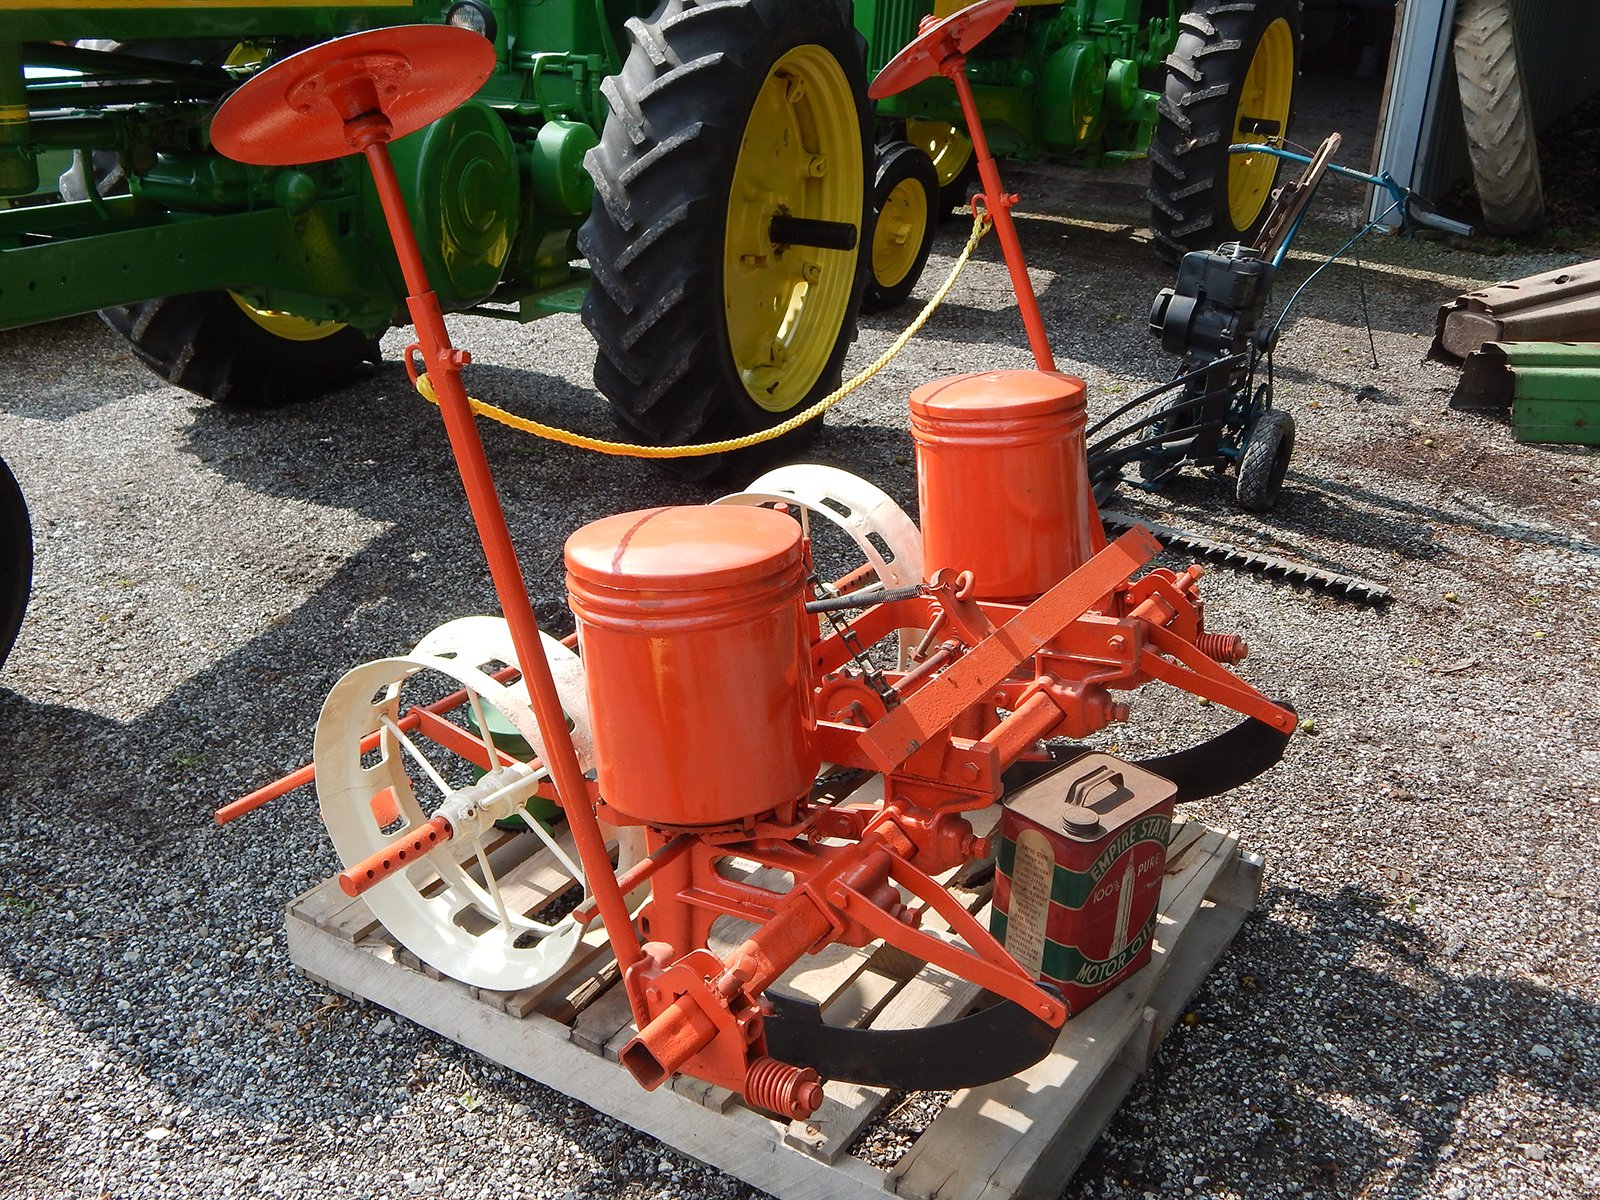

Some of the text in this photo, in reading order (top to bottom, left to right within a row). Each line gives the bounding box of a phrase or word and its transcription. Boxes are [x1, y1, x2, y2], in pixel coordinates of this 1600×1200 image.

[1090, 818, 1171, 882] EMPIRE STATE
[1137, 853, 1160, 877] PURE
[1093, 879, 1120, 904] 100%
[1075, 952, 1127, 983] MOTOR
[1131, 923, 1155, 955] OIL
